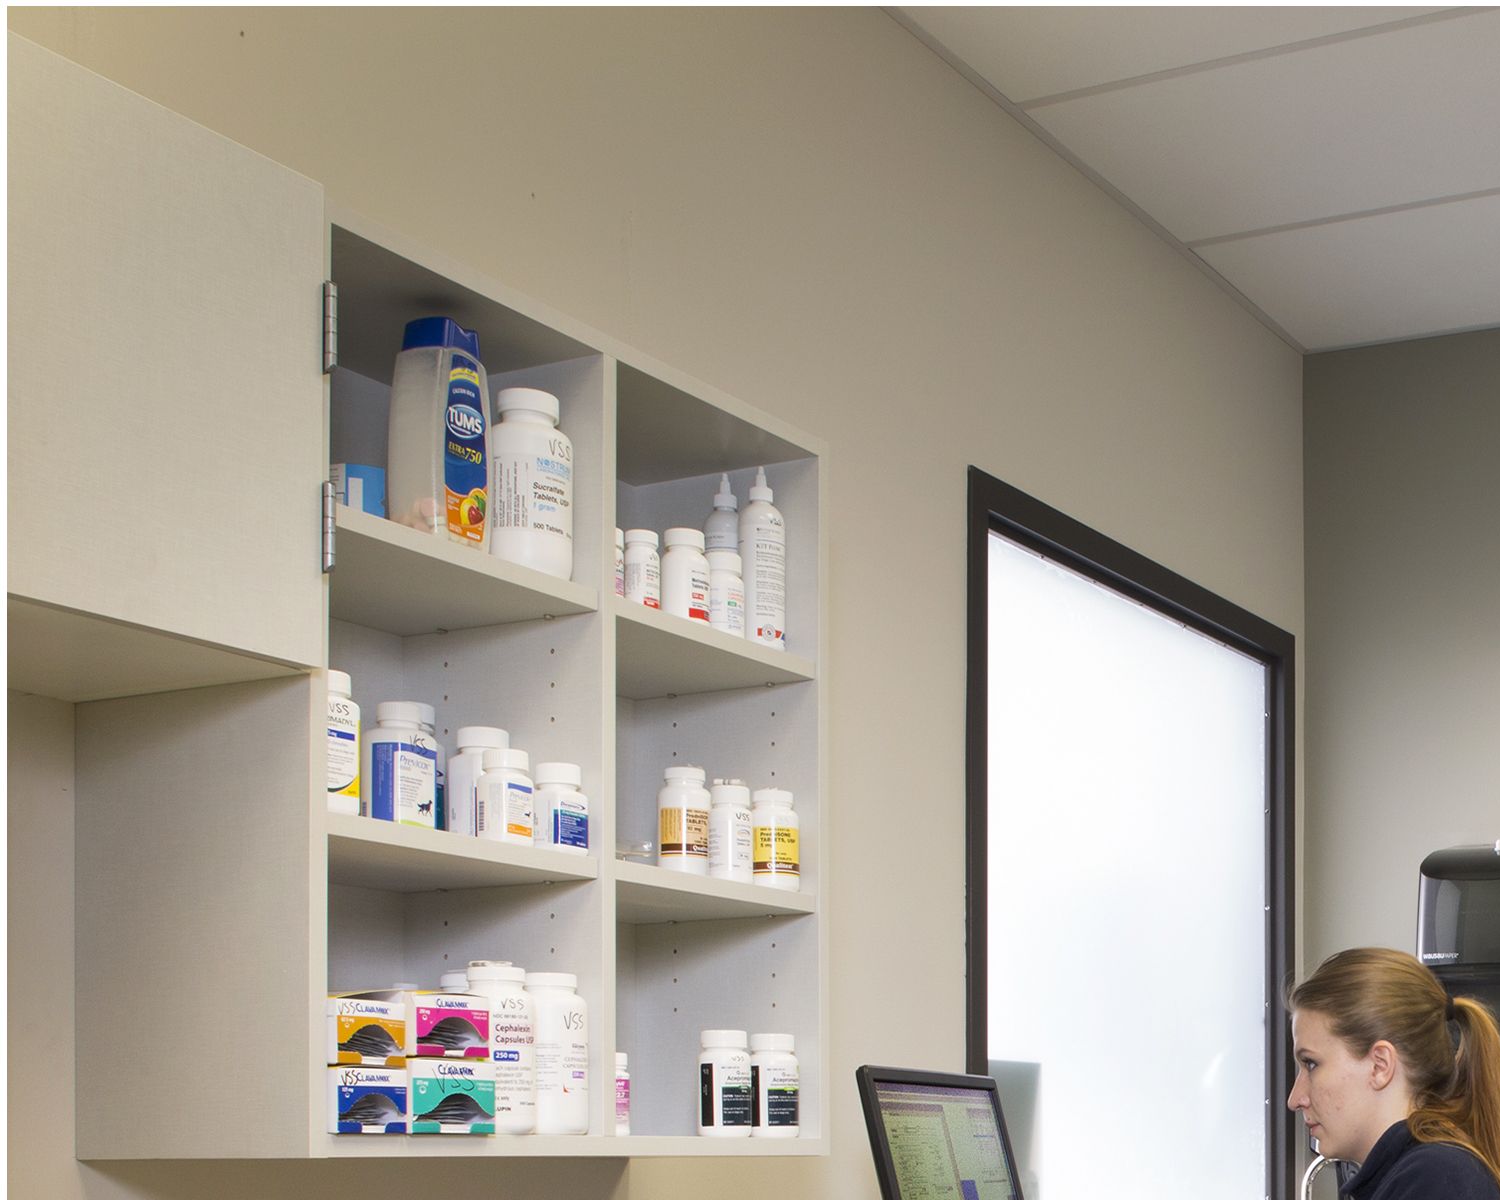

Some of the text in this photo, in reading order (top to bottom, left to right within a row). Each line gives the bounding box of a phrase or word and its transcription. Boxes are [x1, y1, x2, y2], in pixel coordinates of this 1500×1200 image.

[448, 406, 483, 435] TUMS
[464, 447, 482, 465] 750
[548, 439, 571, 462] VSS
[532, 481, 565, 496] Sucralfate
[533, 492, 558, 505] Tablets,
[328, 703, 350, 716] VSS
[735, 812, 751, 822] VSS
[337, 1002, 355, 1015] VSS
[500, 998, 525, 1011] VSS
[563, 1011, 584, 1030] VSS
[495, 1035, 525, 1044] Capsules
[508, 1052, 518, 1060] mg
[341, 1069, 358, 1087] VSS
